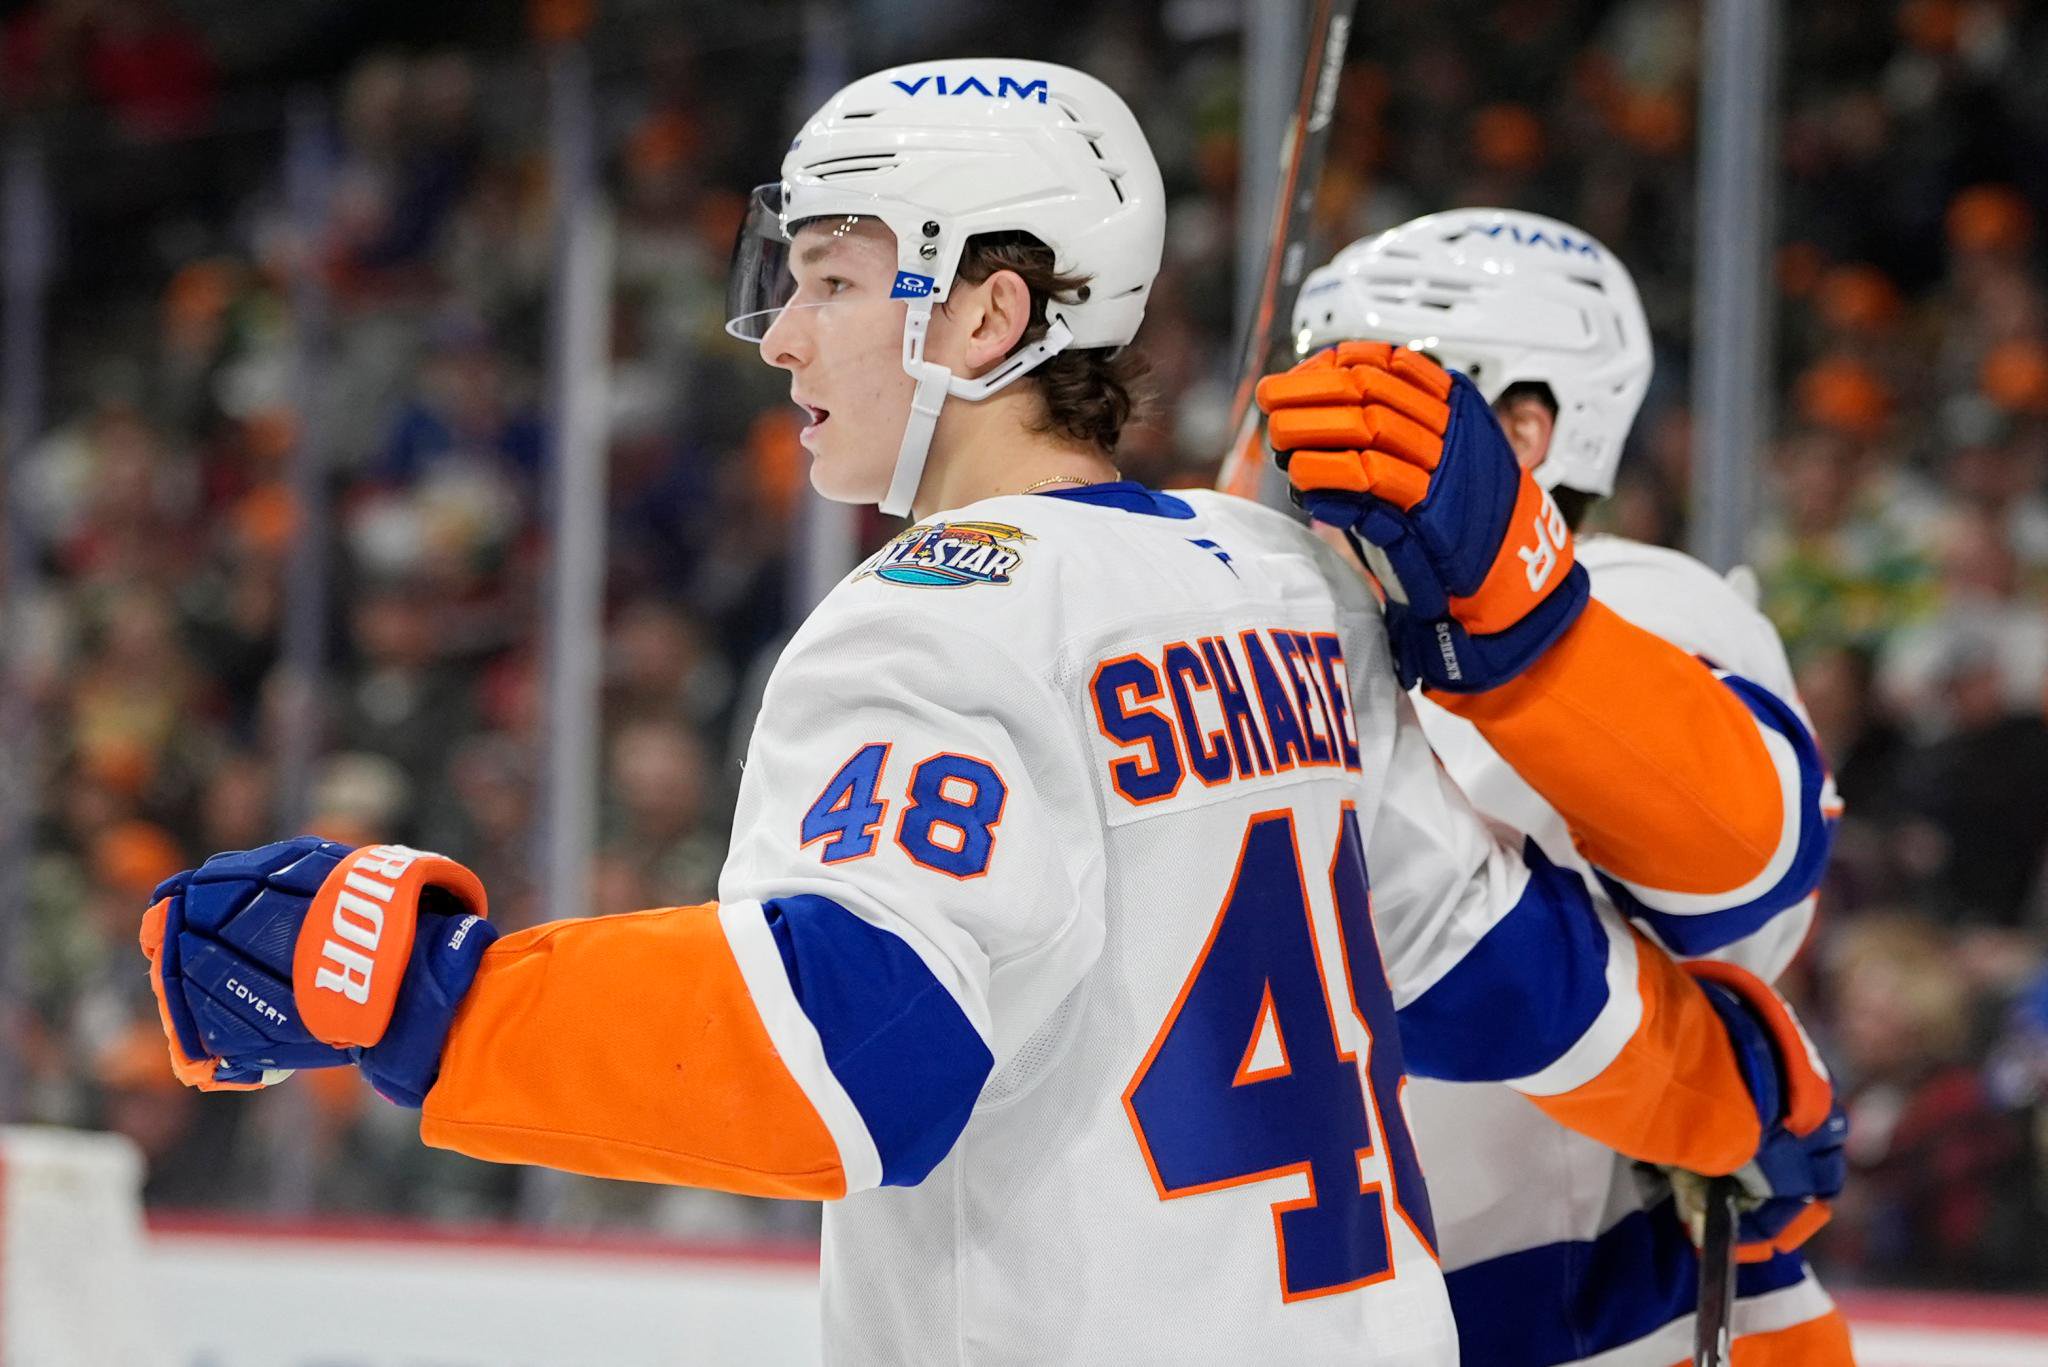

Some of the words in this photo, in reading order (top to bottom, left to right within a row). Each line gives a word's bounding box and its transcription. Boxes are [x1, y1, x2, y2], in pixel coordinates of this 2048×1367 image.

[890, 76, 1048, 105] VIAM
[1467, 223, 1600, 262] VIAM
[918, 538, 1021, 577] STAR
[1088, 628, 1363, 806] SCHAEFE
[800, 742, 1009, 882] 48
[225, 977, 288, 1027] COVERT
